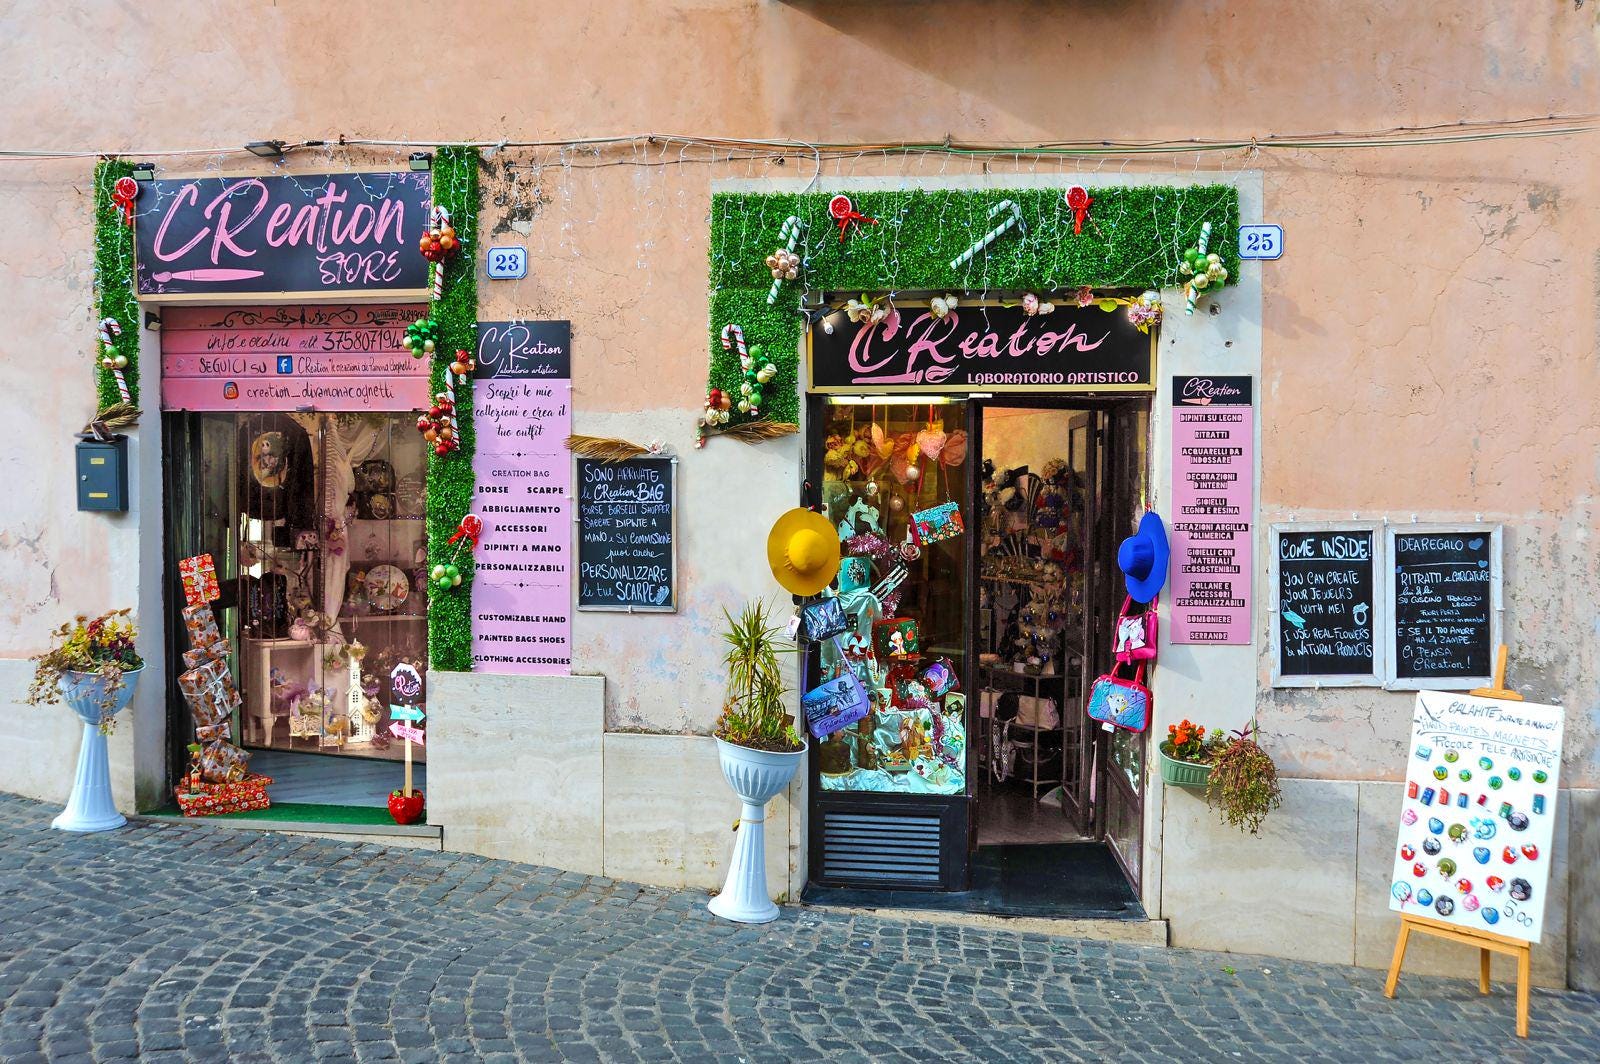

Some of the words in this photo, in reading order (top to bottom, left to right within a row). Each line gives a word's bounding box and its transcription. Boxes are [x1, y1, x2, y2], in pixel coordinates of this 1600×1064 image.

[1247, 233, 1273, 251] 25
[316, 250, 402, 285] STORE
[495, 254, 519, 272] 23
[208, 333, 238, 351] info
[322, 329, 408, 351] 375807194
[199, 357, 246, 374] SEGUICI
[491, 358, 529, 378] Laboratorio
[531, 363, 558, 374] artistico
[967, 372, 1063, 384] LABORATORIO
[1067, 371, 1139, 384] ARTISTICO
[486, 384, 520, 400] Scopri
[523, 384, 531, 397] le
[536, 386, 553, 398] mie
[475, 404, 519, 422] collezioni
[522, 409, 528, 418] e
[527, 408, 554, 420] crea
[558, 405, 566, 417] il
[1180, 414, 1206, 422] DIPINTI
[1208, 414, 1217, 422] SU
[1219, 414, 1242, 422] LEGNO
[496, 425, 512, 437] tuo
[516, 425, 545, 441] outfit
[1195, 431, 1228, 439] RITRATTI
[1182, 448, 1228, 456] ACQUARELLI
[1230, 448, 1240, 456] DA
[1190, 456, 1231, 464] INDOSSARE
[585, 464, 613, 482] SONO
[617, 467, 659, 482] ARRIVATE
[1187, 473, 1236, 481] DECORAZIONI
[479, 486, 509, 494] BORSE
[527, 486, 564, 494] SCARPE
[581, 487, 592, 500] le
[637, 482, 664, 501] BAG
[1196, 498, 1225, 506] GIOIELLI
[482, 505, 561, 513] ABBIGLIAMENTO
[581, 504, 603, 515] BORSE
[641, 503, 670, 514] SHOPPER
[1182, 506, 1205, 514] LEGNO
[651, 518, 657, 526] A
[1174, 523, 1213, 531] CREAZIONI
[1215, 523, 1246, 531] ARGILLA
[584, 532, 607, 543] MANO
[616, 533, 627, 543] SU
[1189, 532, 1231, 540] POLIMERICA
[1281, 538, 1314, 559] COME
[1321, 534, 1372, 558] INSIDE!
[1421, 538, 1464, 551] REGALO
[605, 547, 630, 563] puoi
[632, 549, 658, 558] anche
[1187, 548, 1216, 556] GIOIELLI
[1218, 548, 1233, 556] CON
[475, 563, 564, 572] PERSONALIZZABILI
[581, 562, 667, 583] PERSONALIZZARE
[1182, 565, 1239, 573] ECOSOSTENIBILI
[1282, 571, 1303, 587] YOU
[1307, 571, 1324, 585] CAN
[1326, 570, 1360, 585] CREATE
[1400, 572, 1442, 586] RITRATTI
[1190, 582, 1222, 590] COLLANE
[1224, 582, 1230, 590] E
[581, 583, 593, 597] le
[597, 583, 614, 597] tue
[616, 582, 656, 603] SCARPE
[1190, 590, 1230, 598] ACCESSORI
[1285, 588, 1308, 602] YOUR
[1176, 598, 1243, 607] PERSONALIZZABILI
[1411, 596, 1442, 604] CUSCINO
[1300, 603, 1324, 614] WITH
[1187, 615, 1231, 623] BOMBONIERE
[1190, 632, 1228, 640] SERRANDE
[1283, 630, 1290, 642] I
[1293, 629, 1311, 640] USE
[1312, 627, 1334, 640] REAL
[1334, 627, 1370, 640] FLOWERS
[1397, 628, 1404, 636] E
[1408, 627, 1421, 636] SE
[1435, 626, 1448, 634] TUO
[1450, 626, 1475, 635] AMORE
[1428, 635, 1437, 644] 4
[1297, 640, 1335, 656] NATURAL
[1335, 641, 1373, 658] PRODUCTS
[1402, 645, 1414, 658] CI
[1416, 646, 1453, 658] PENSA
[1450, 722, 1490, 737] PAINTED
[1493, 730, 1549, 747] MAGNETS
[1432, 736, 1473, 750] PICCOLE
[1481, 742, 1507, 755] TELE
